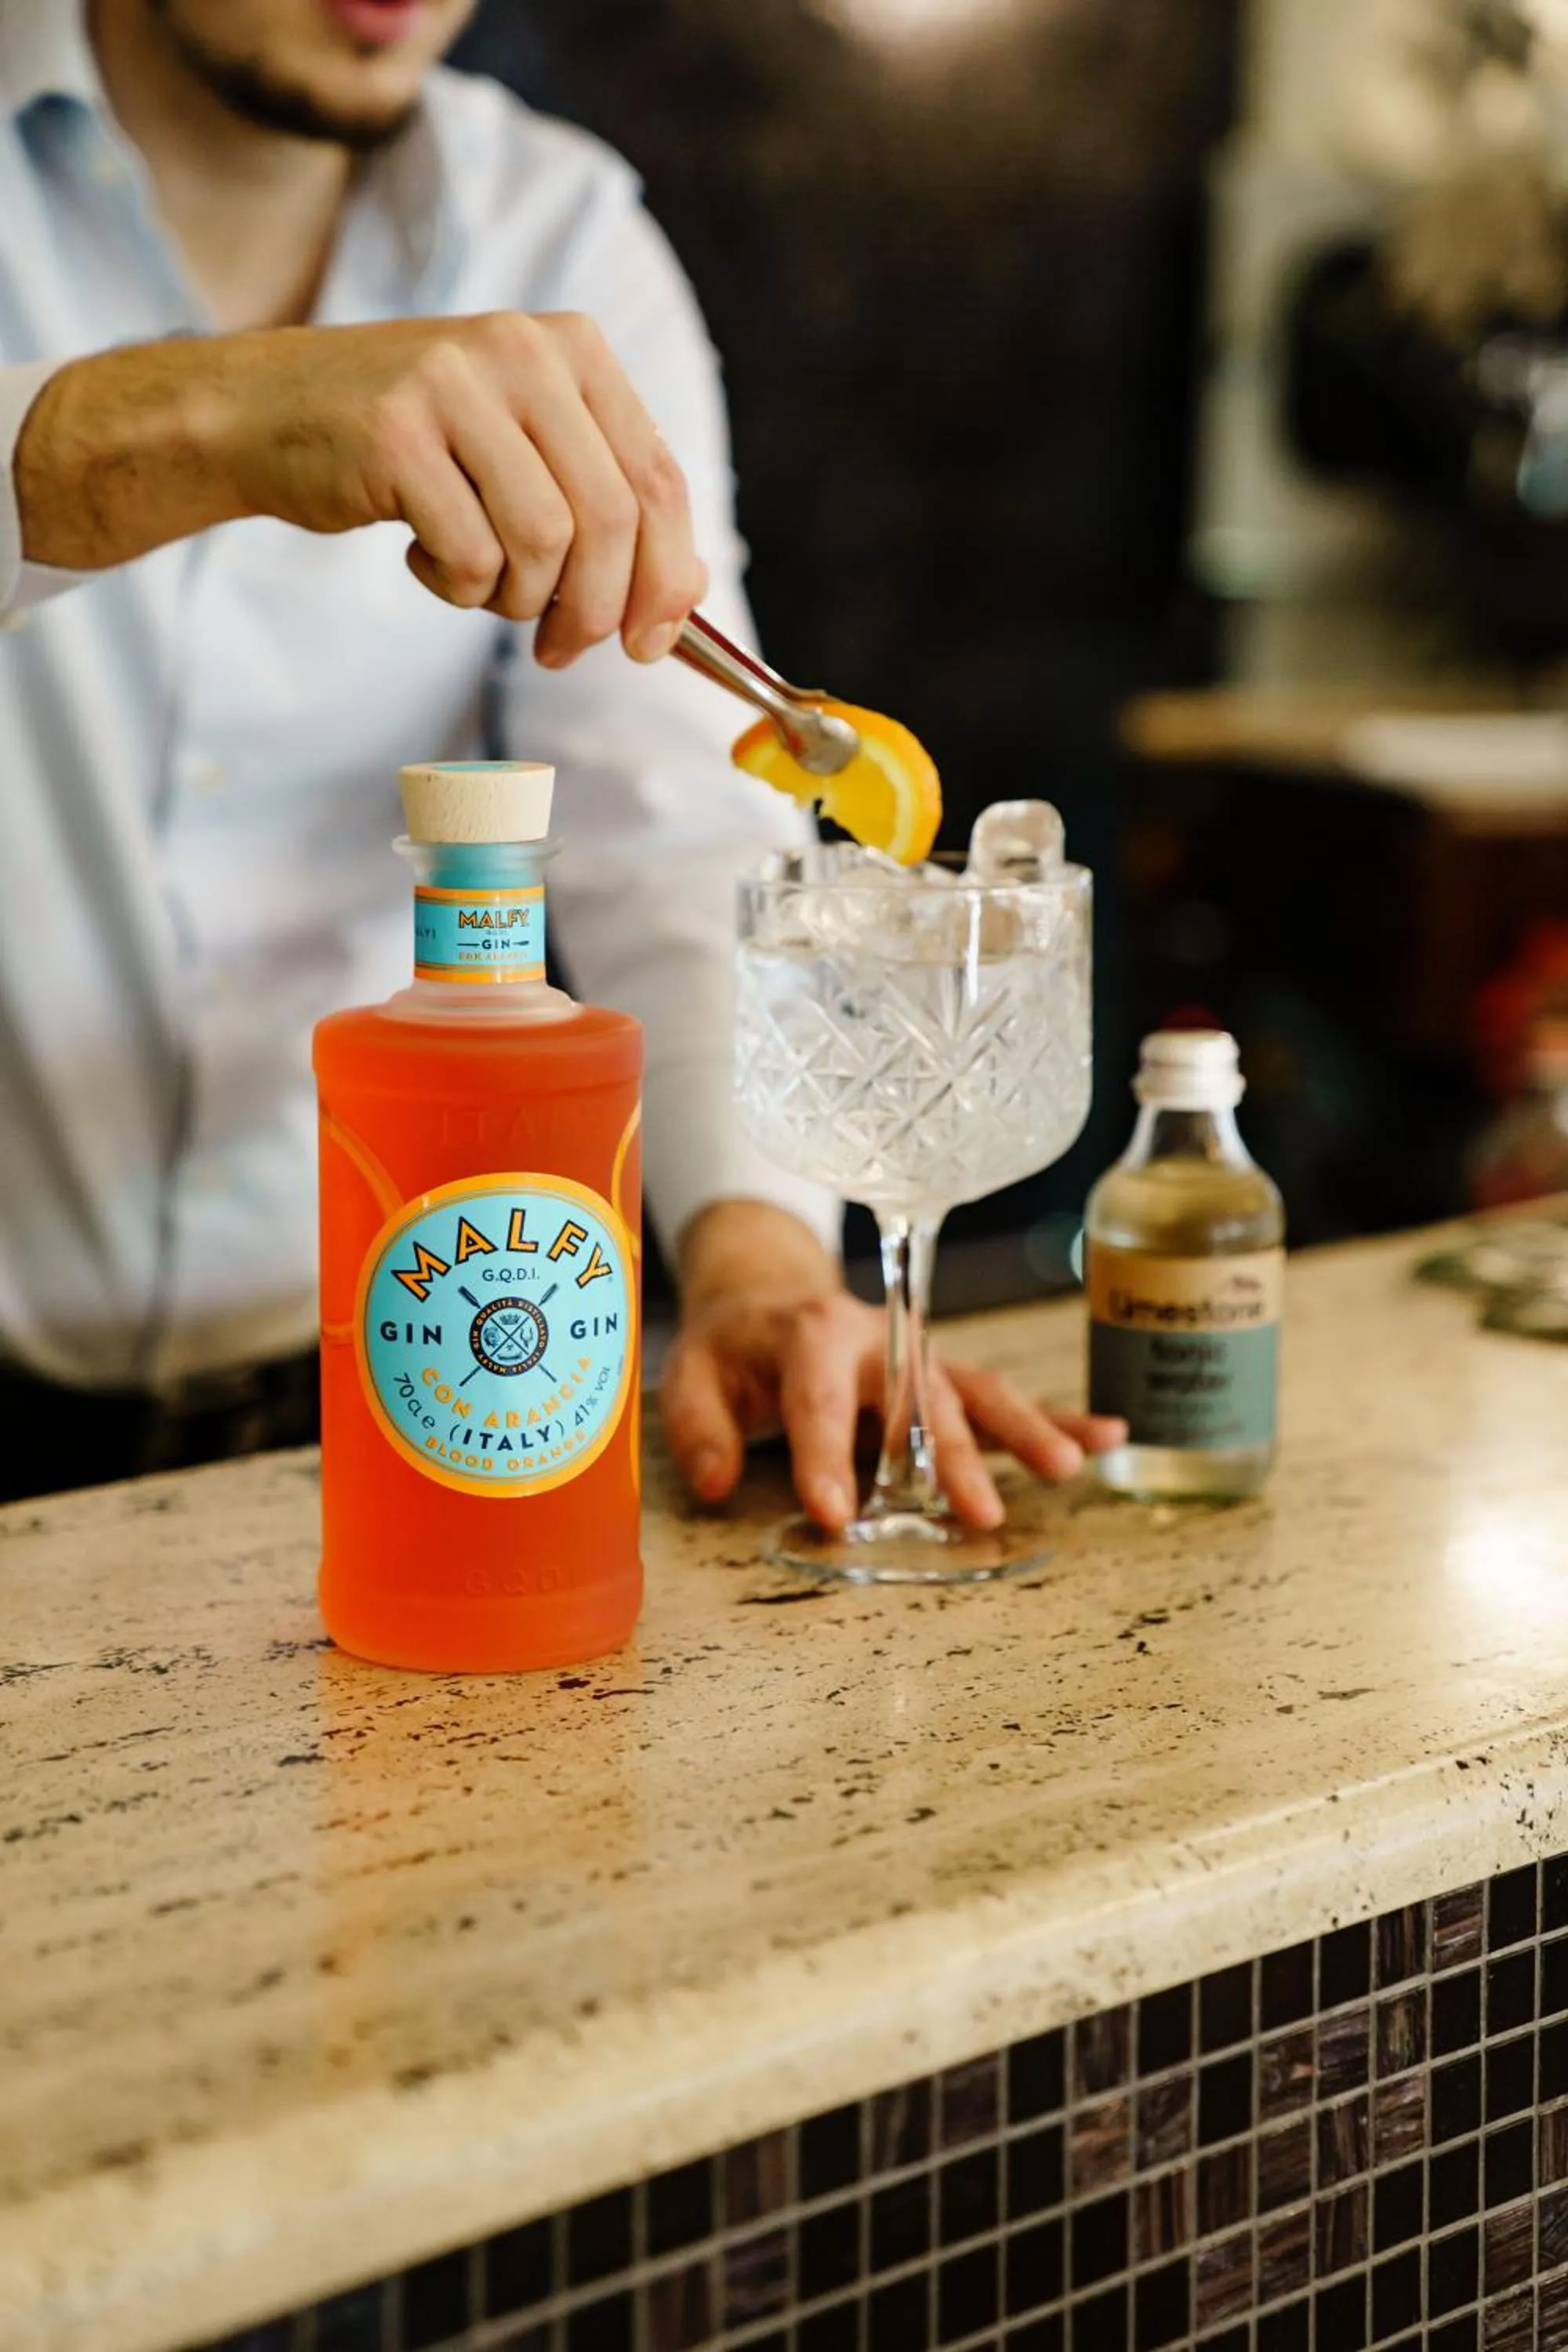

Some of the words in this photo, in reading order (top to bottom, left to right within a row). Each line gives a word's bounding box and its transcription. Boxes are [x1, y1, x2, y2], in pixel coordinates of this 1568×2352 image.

[459, 909, 529, 928] MALFY
[482, 938, 510, 949] GIN
[391, 1207, 613, 1302] MALFY
[380, 1321, 442, 1345] GIN
[570, 1312, 618, 1340] GIN
[422, 1367, 473, 1418] CON
[483, 1356, 591, 1428] ARANCIA
[449, 1419, 564, 1451] (ITALY)
[426, 1435, 494, 1472] BLOOD
